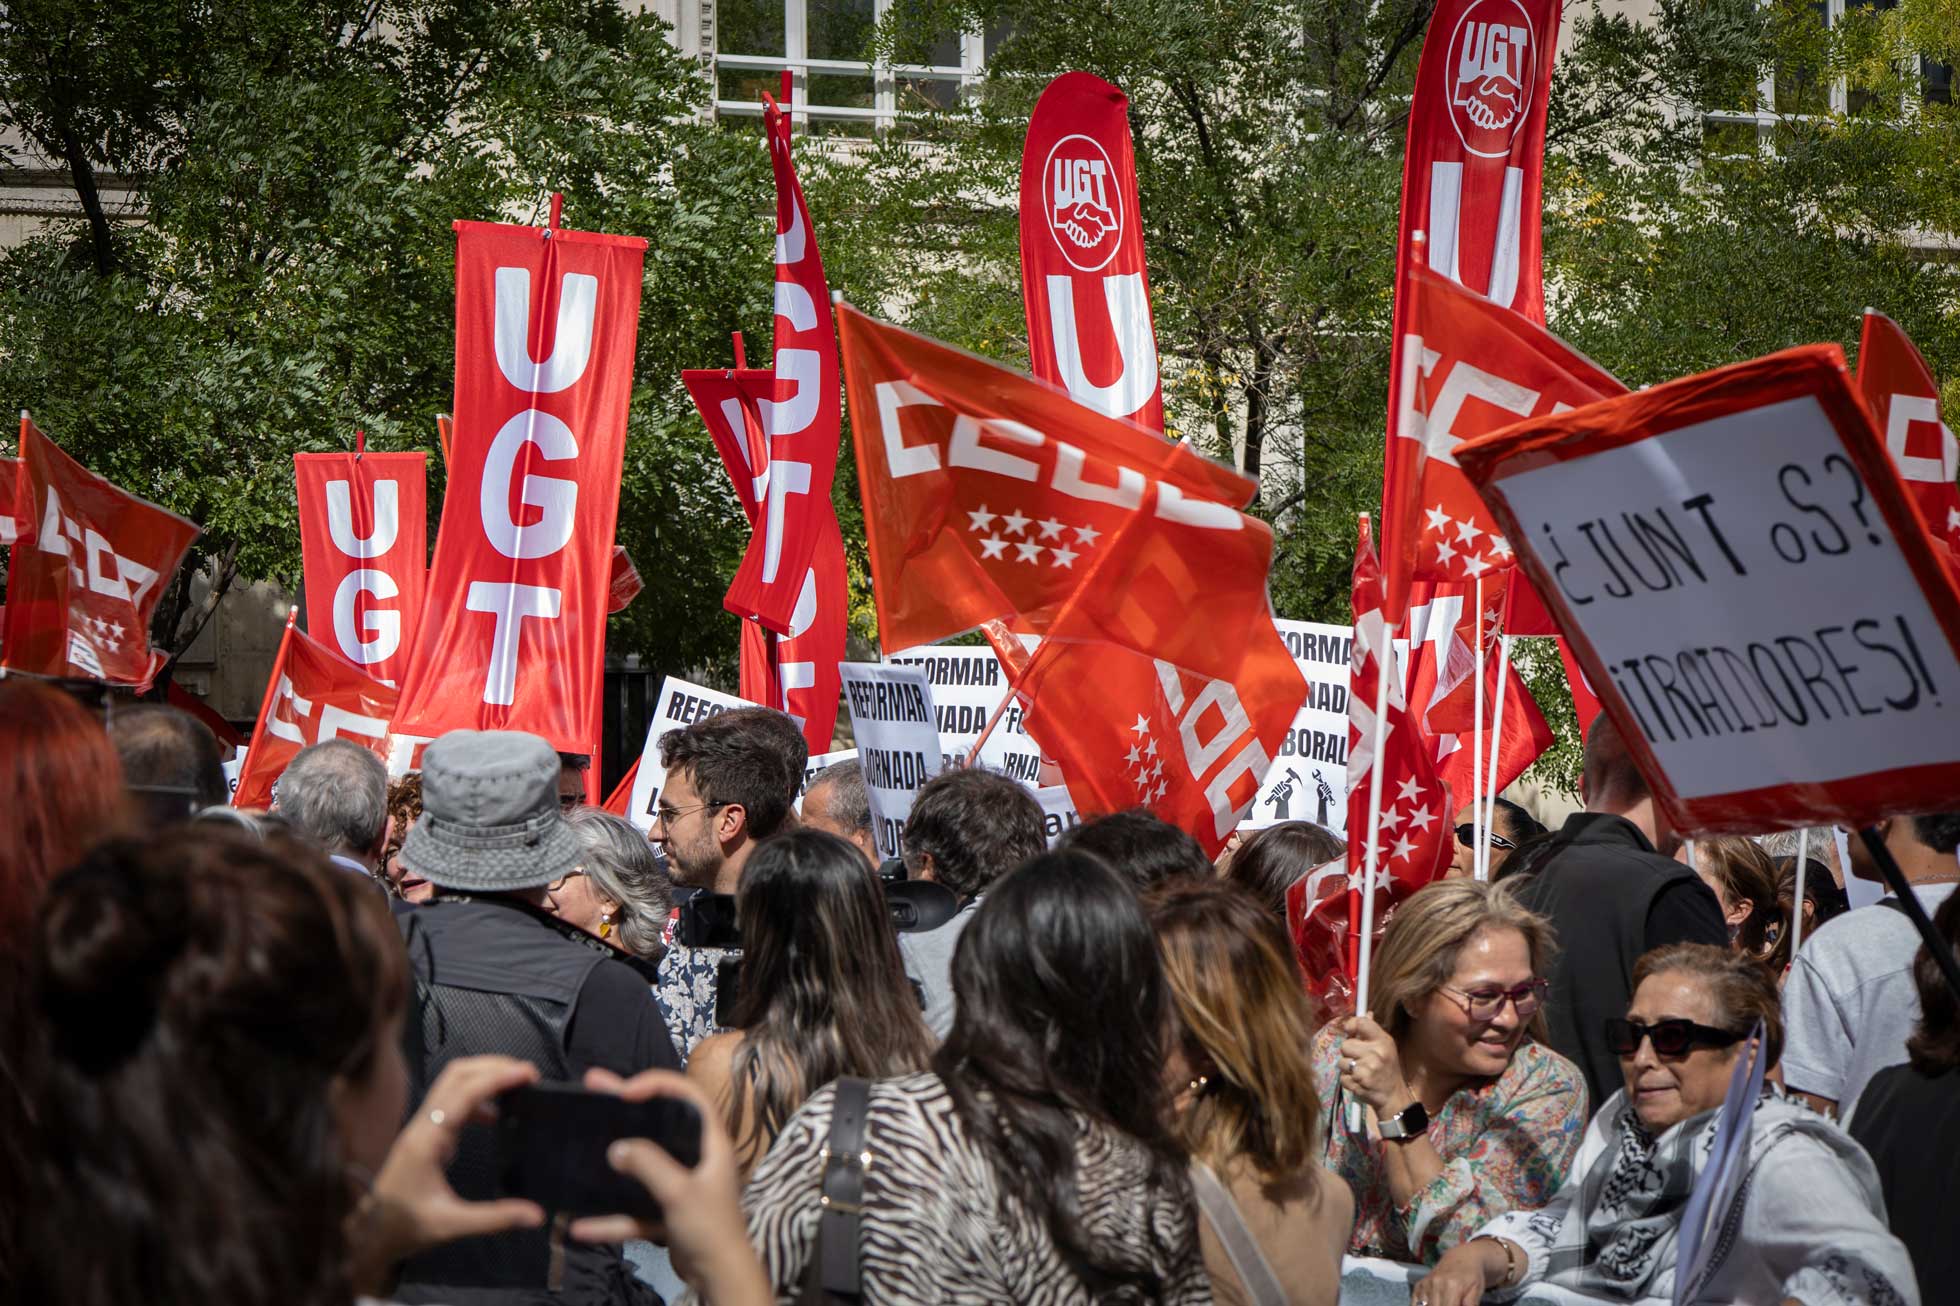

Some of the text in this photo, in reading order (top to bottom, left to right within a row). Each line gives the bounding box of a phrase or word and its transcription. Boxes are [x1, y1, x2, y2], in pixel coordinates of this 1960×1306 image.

[1459, 21, 1527, 88] UGT
[1054, 158, 1107, 210] UGT
[466, 266, 599, 707] UGT
[326, 479, 401, 688] UG
[847, 680, 929, 723] REFORMAR
[864, 747, 928, 791] JORNADA
